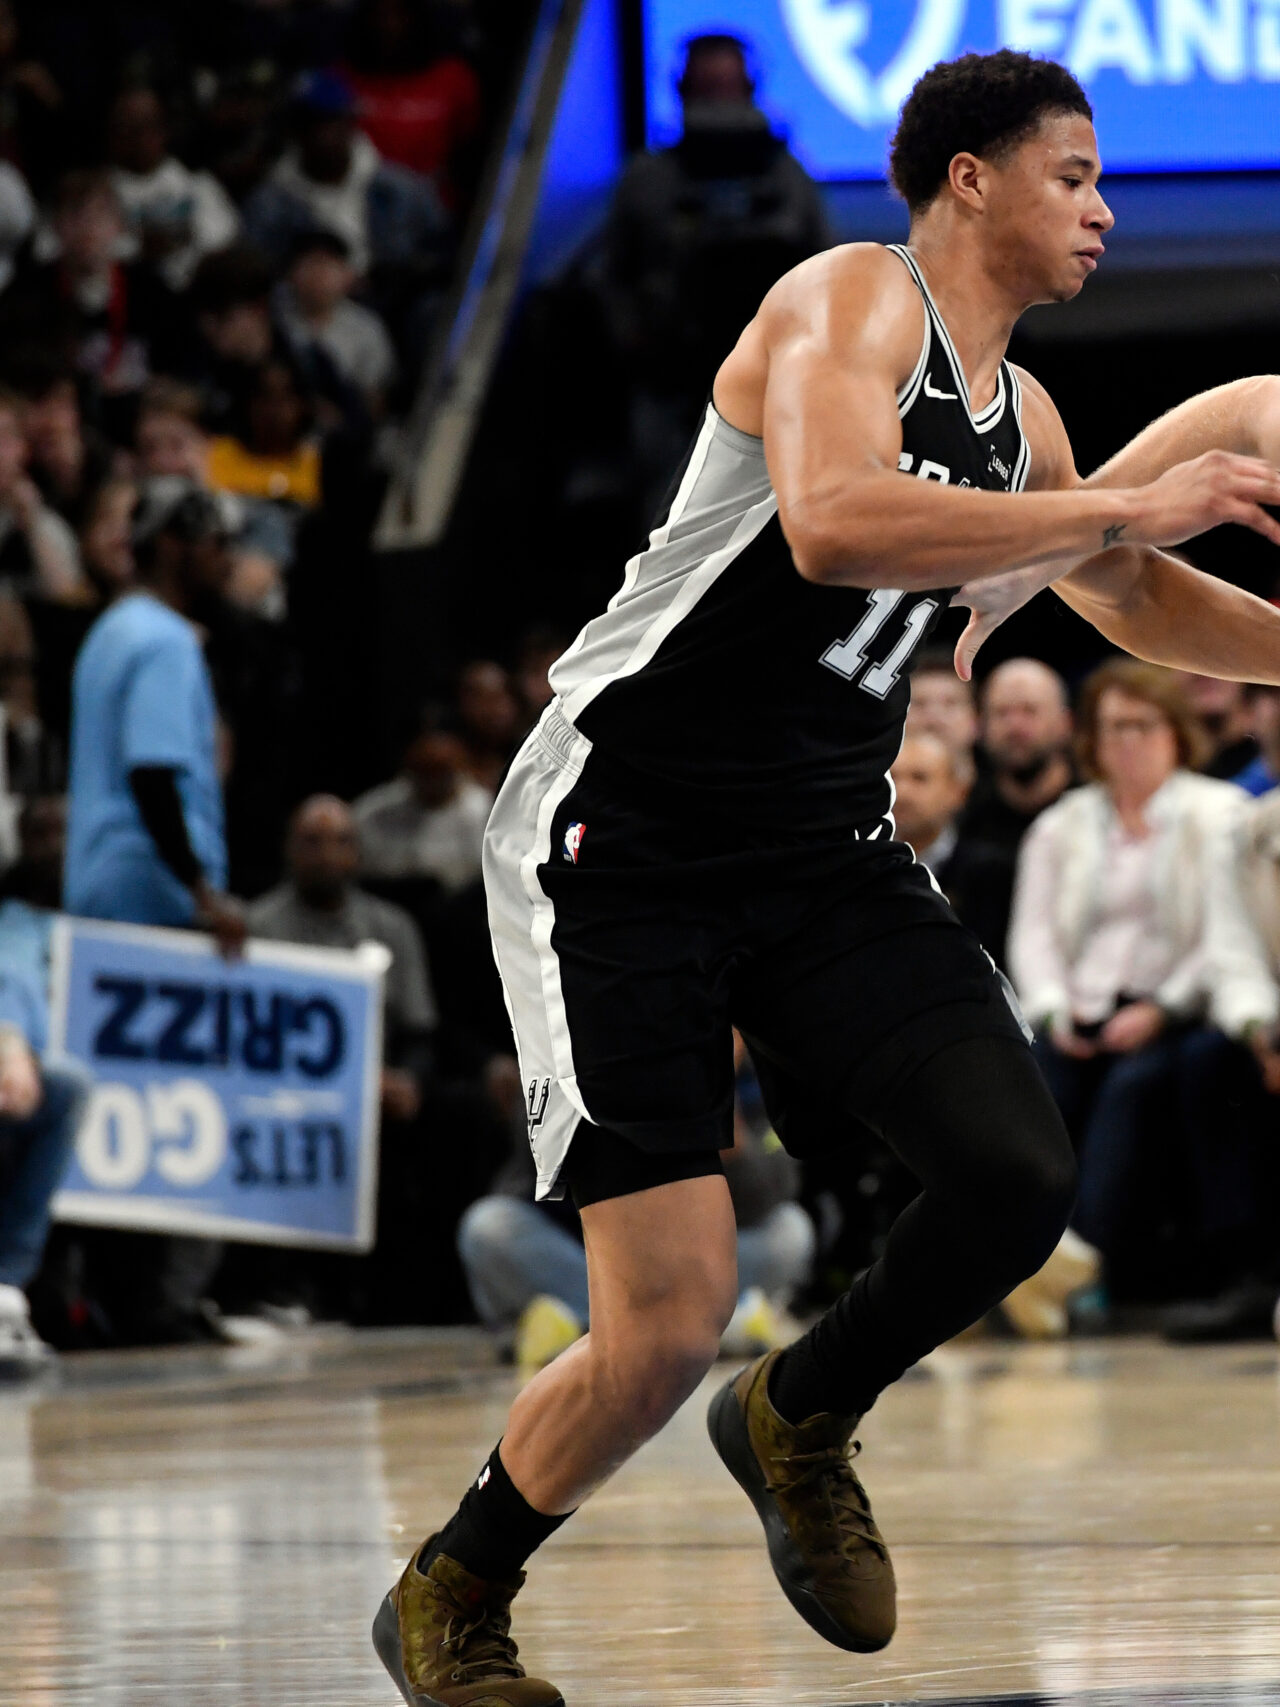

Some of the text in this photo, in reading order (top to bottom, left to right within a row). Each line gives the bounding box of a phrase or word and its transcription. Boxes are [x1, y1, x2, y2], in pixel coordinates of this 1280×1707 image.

[818, 588, 940, 700] 11
[93, 972, 346, 1079] GRIZZ
[78, 1079, 228, 1190] GO
